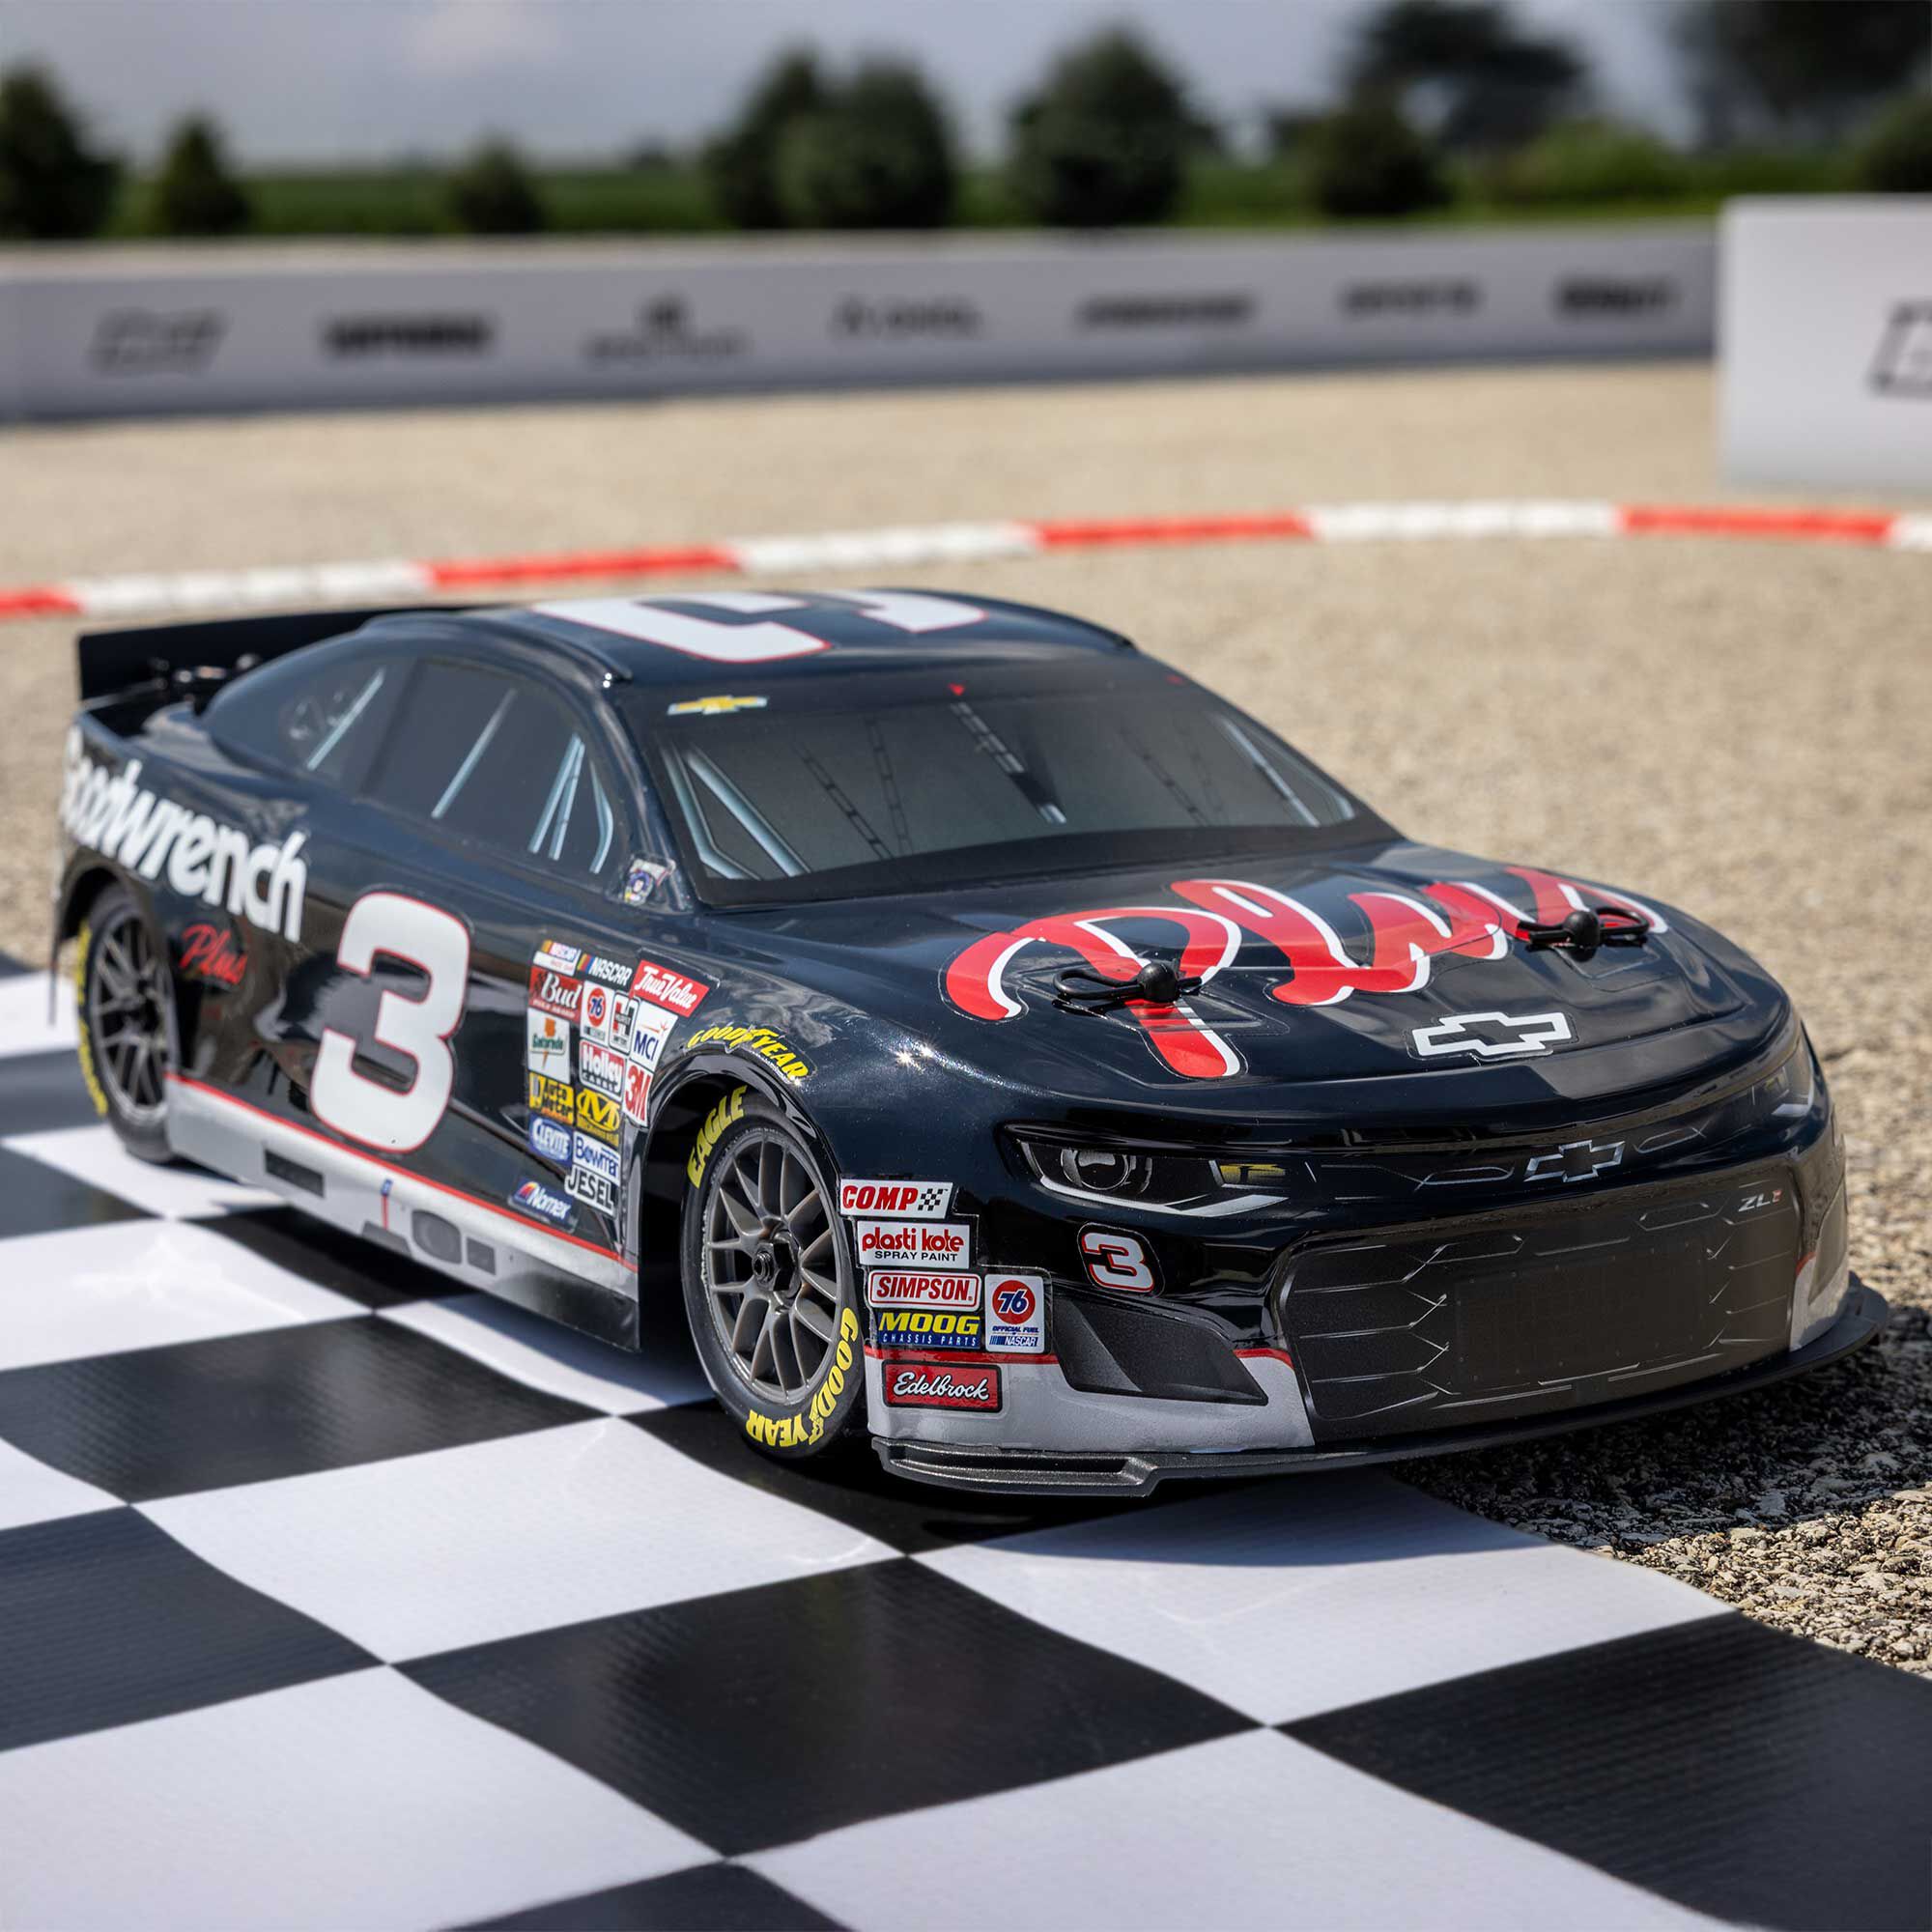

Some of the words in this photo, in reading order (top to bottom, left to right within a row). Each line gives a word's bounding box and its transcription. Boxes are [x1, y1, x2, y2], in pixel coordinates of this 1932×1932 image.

[178, 923, 248, 985] Plus
[588, 956, 633, 986] NASCAR
[541, 972, 582, 1009] Bud
[588, 998, 604, 1016] 76
[310, 891, 470, 1154] 3
[634, 1030, 659, 1061] MCI
[582, 1042, 624, 1092] Holley
[625, 1065, 651, 1122] 3M
[687, 1084, 748, 1188] EAGLE
[526, 1187, 571, 1219] Nomex
[566, 1167, 614, 1209] JESEL
[842, 1184, 919, 1211] COMP
[862, 1227, 917, 1252] plasti
[922, 1228, 964, 1252] kote
[874, 1250, 918, 1261] SPRAY
[921, 1252, 958, 1263] PAINT
[1082, 1232, 1154, 1293] 3
[876, 1275, 968, 1301] SIMPSON
[998, 1288, 1029, 1315] 76
[878, 1312, 980, 1336] MOOG
[992, 1324, 1021, 1333] OFFICIAL
[882, 1333, 932, 1345] CHASSIS
[941, 1335, 978, 1347] PARTS
[1005, 1335, 1038, 1347] NASCAR
[893, 1371, 990, 1401] Edelbrock
